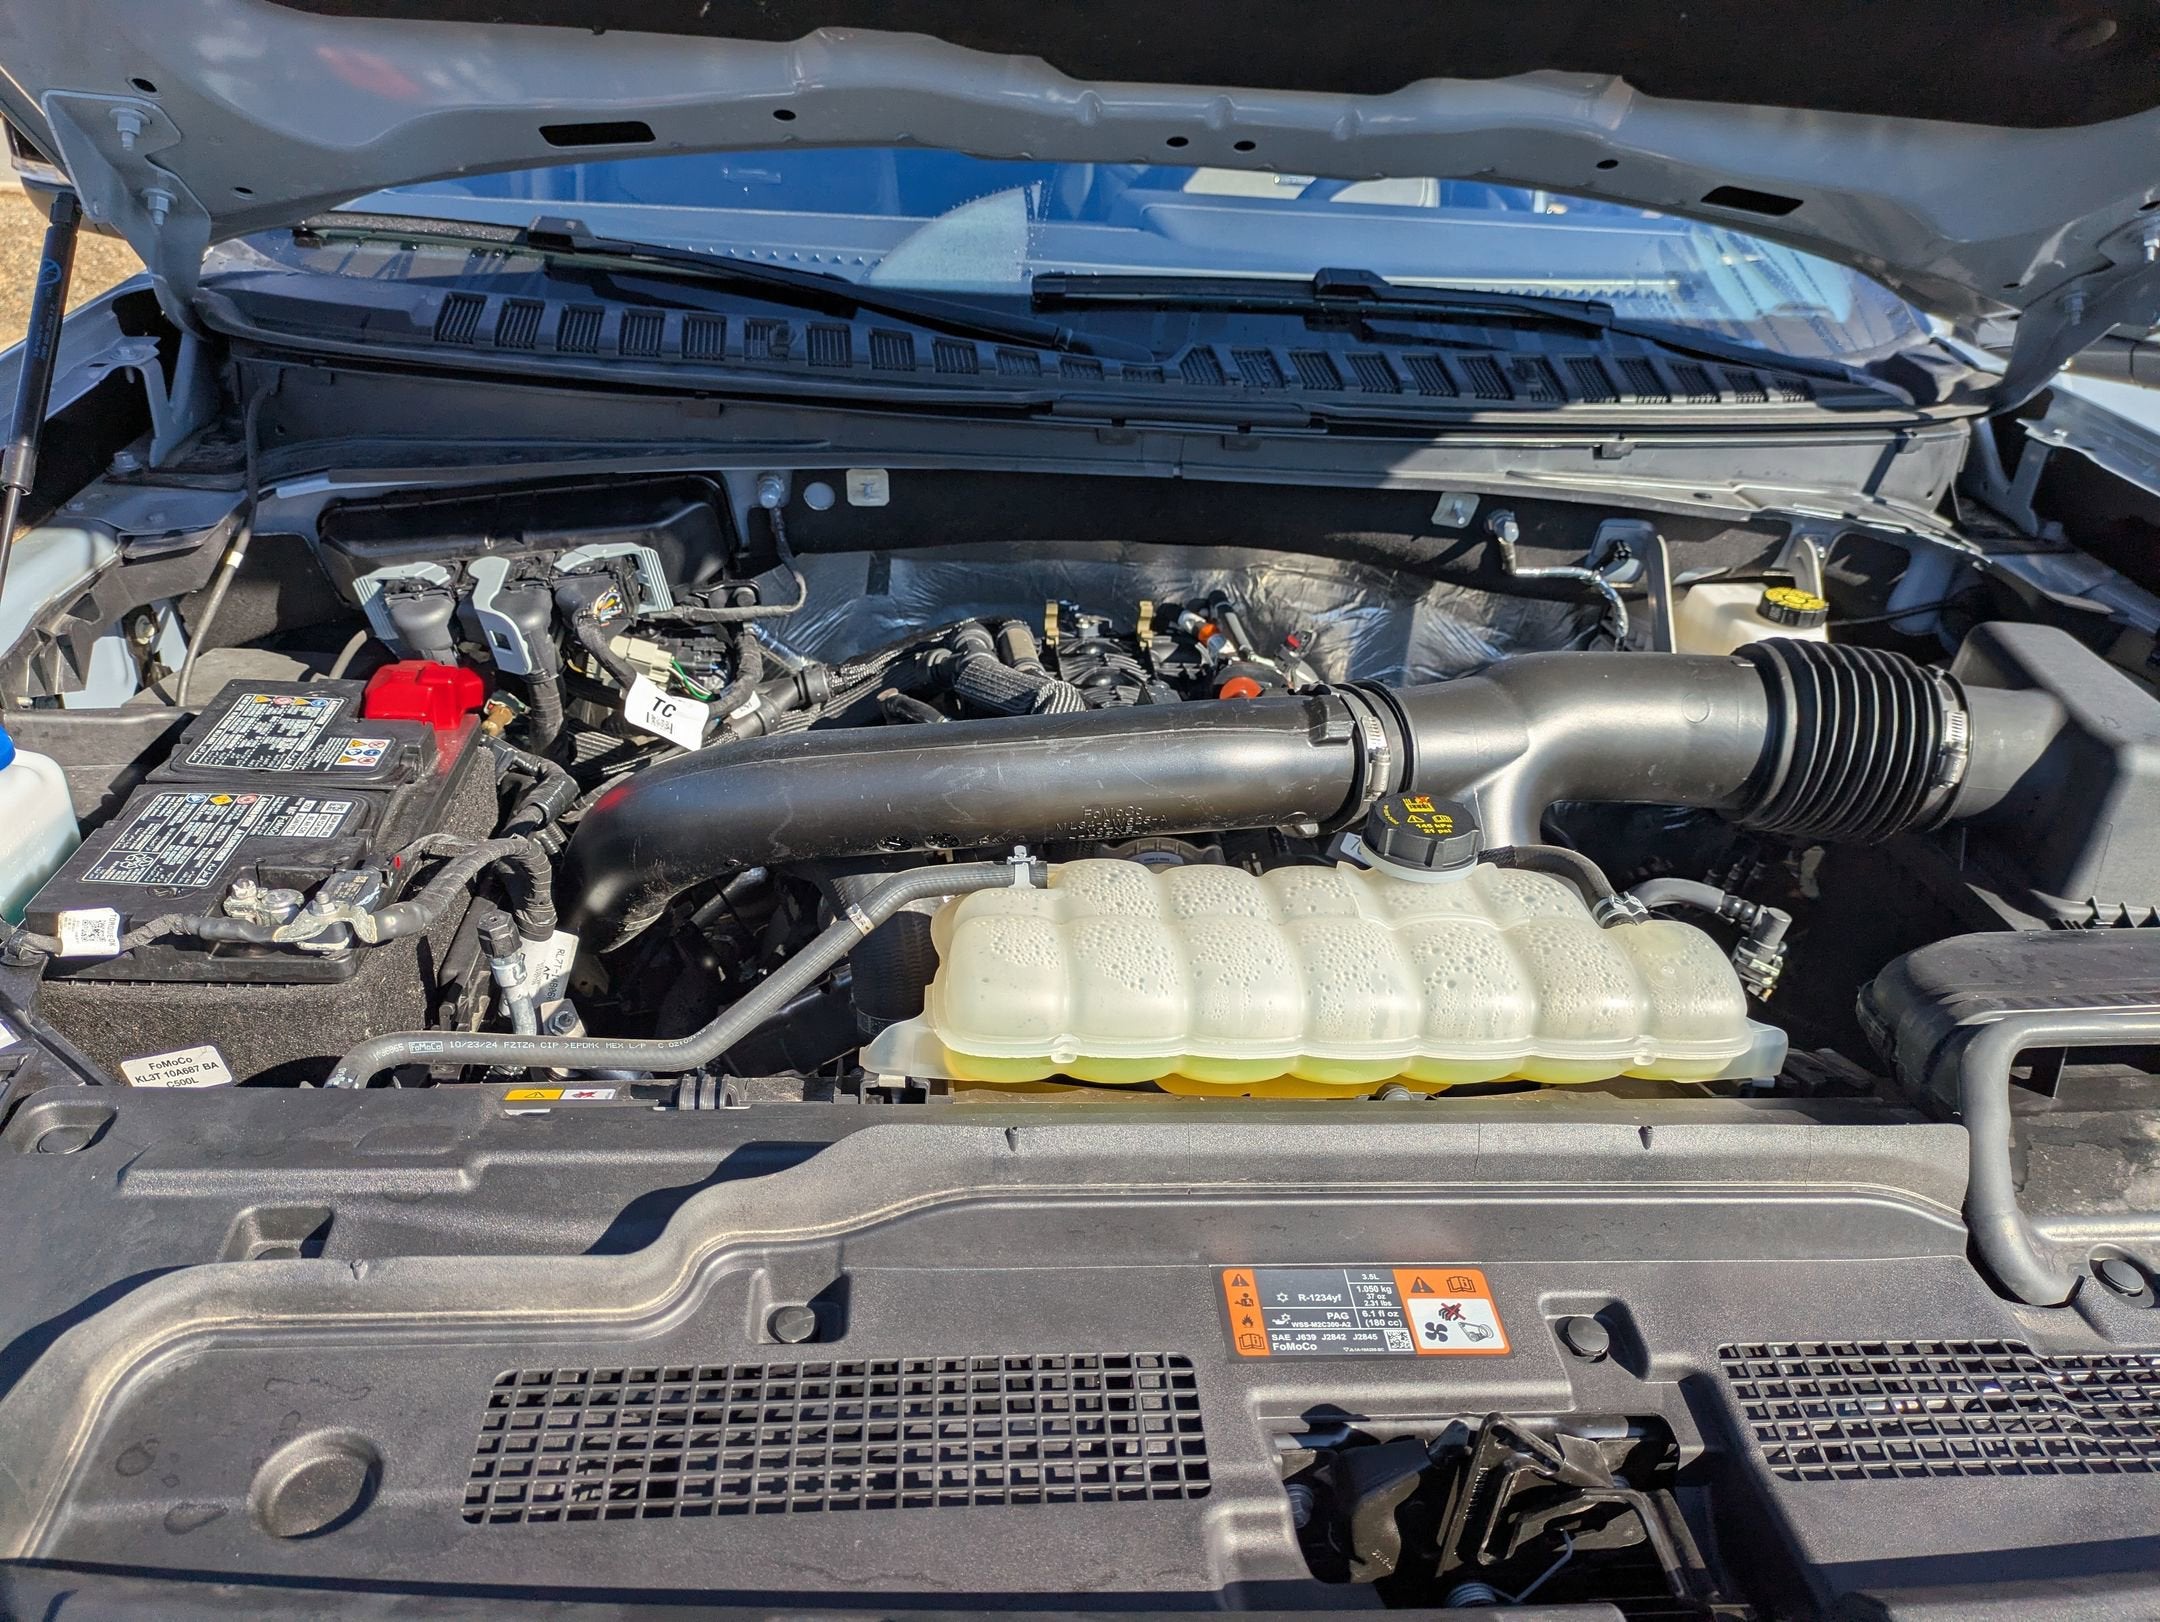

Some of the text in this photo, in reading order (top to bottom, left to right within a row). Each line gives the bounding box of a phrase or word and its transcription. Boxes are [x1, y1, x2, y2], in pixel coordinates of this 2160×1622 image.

[651, 697, 676, 718] TC
[411, 1042, 442, 1052] FoMoCo
[148, 1056, 193, 1071] FoMoCo
[134, 1061, 220, 1084] KL3T 10A687 BA
[166, 1077, 199, 1088] C500L
[1356, 1285, 1393, 1295] 1.050 kg
[1297, 1293, 1342, 1304] R-1234yf
[1326, 1311, 1350, 1320] PAG
[1361, 1310, 1376, 1318] 6.1
[1365, 1319, 1403, 1328] (180 cc)
[1271, 1333, 1378, 1341] SAE J639 J2842 J2845
[1272, 1342, 1318, 1351] FoMoCo
